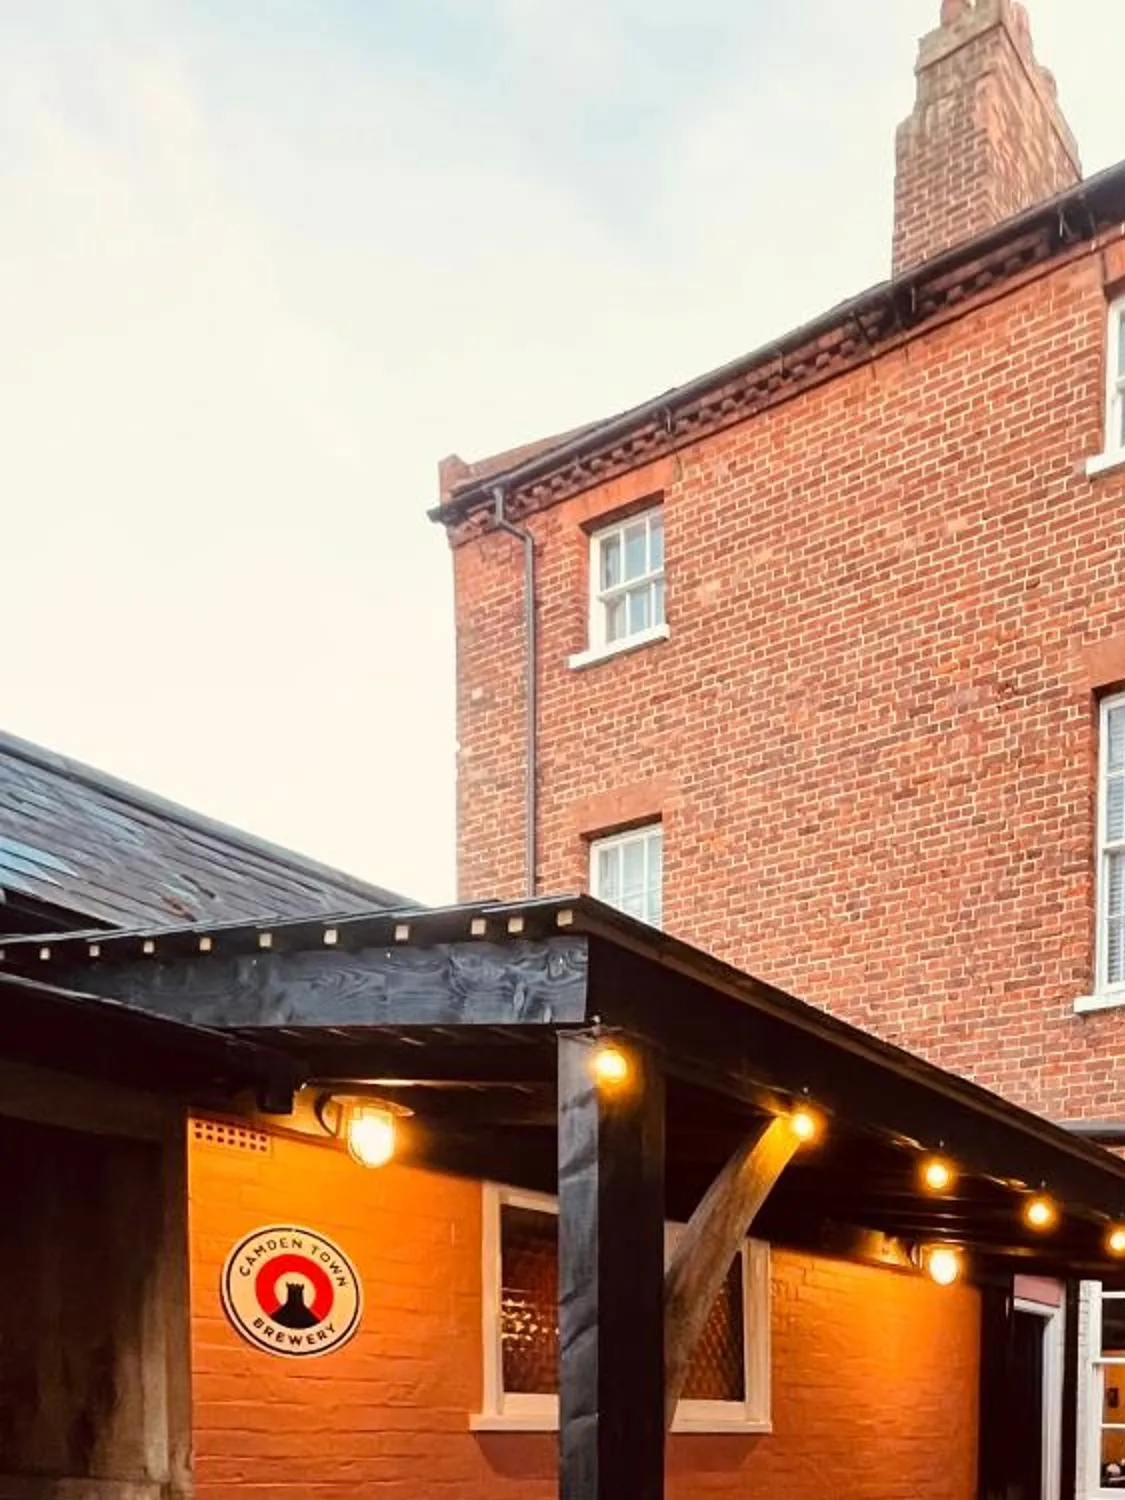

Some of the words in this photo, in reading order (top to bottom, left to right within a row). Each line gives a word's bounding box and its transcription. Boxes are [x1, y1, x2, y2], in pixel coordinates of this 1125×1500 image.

[240, 1238, 303, 1276] CAMDEN
[311, 1245, 348, 1287] TOWN
[253, 1318, 336, 1346] BREWERY
